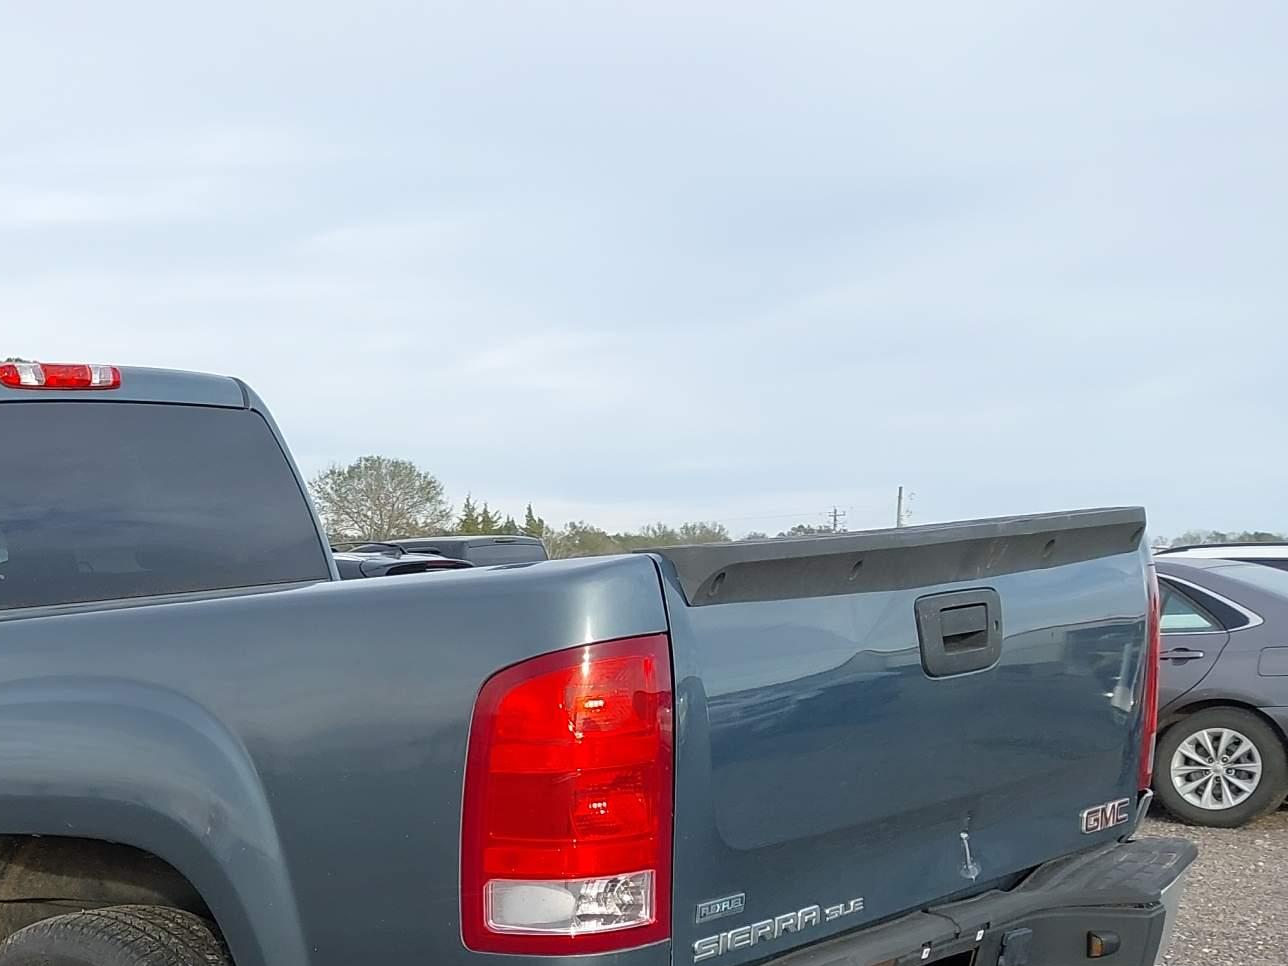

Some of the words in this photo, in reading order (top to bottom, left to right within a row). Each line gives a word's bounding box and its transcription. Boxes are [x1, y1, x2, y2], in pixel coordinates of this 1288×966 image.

[1081, 798, 1130, 834] GMC
[694, 905, 821, 963] SIERRA
[825, 897, 865, 922] SLE
